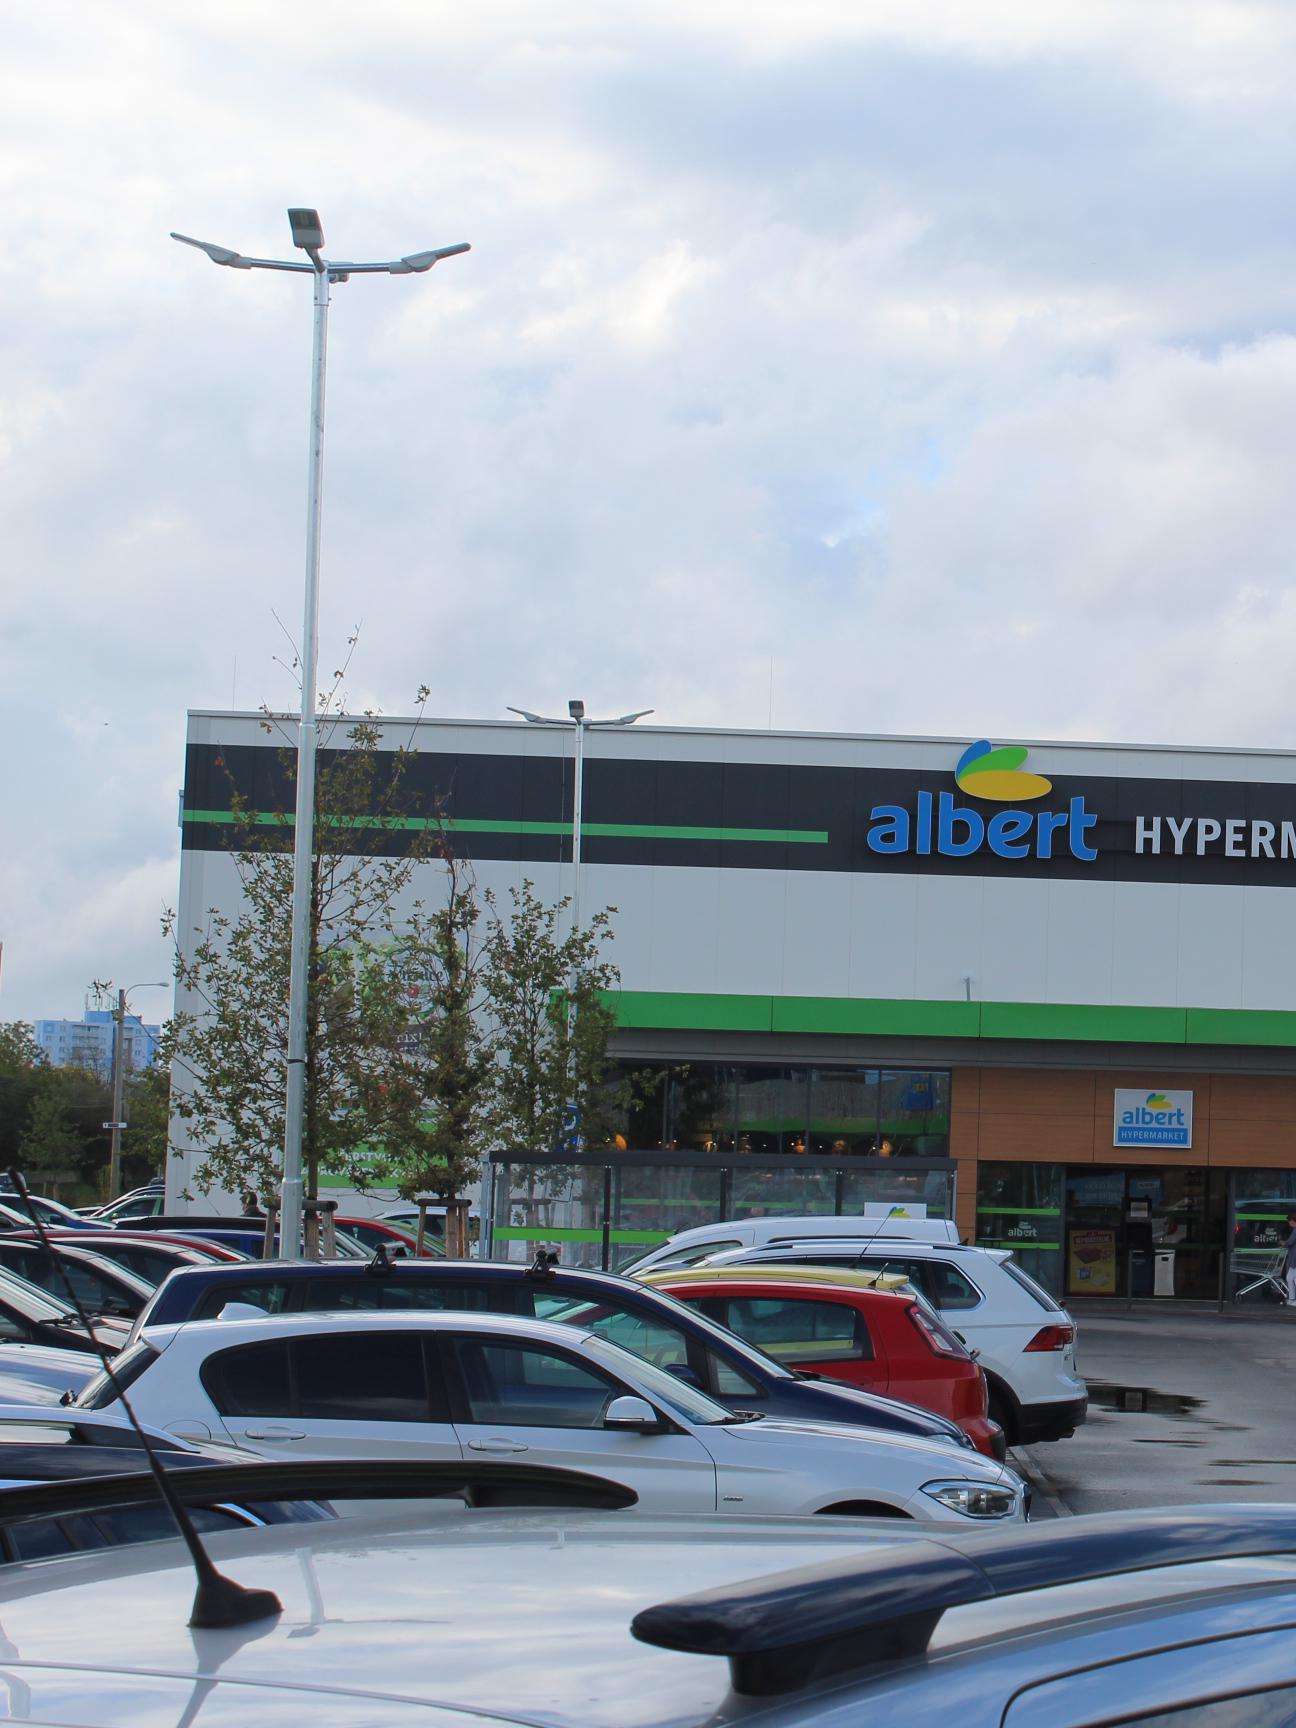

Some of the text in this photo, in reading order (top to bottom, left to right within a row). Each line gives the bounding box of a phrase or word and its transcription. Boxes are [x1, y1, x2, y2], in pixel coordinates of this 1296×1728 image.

[866, 790, 1098, 861] albert
[1121, 1106, 1185, 1126] albert
[1120, 1129, 1185, 1141] HYPERMARKET
[1007, 1224, 1037, 1238] albert
